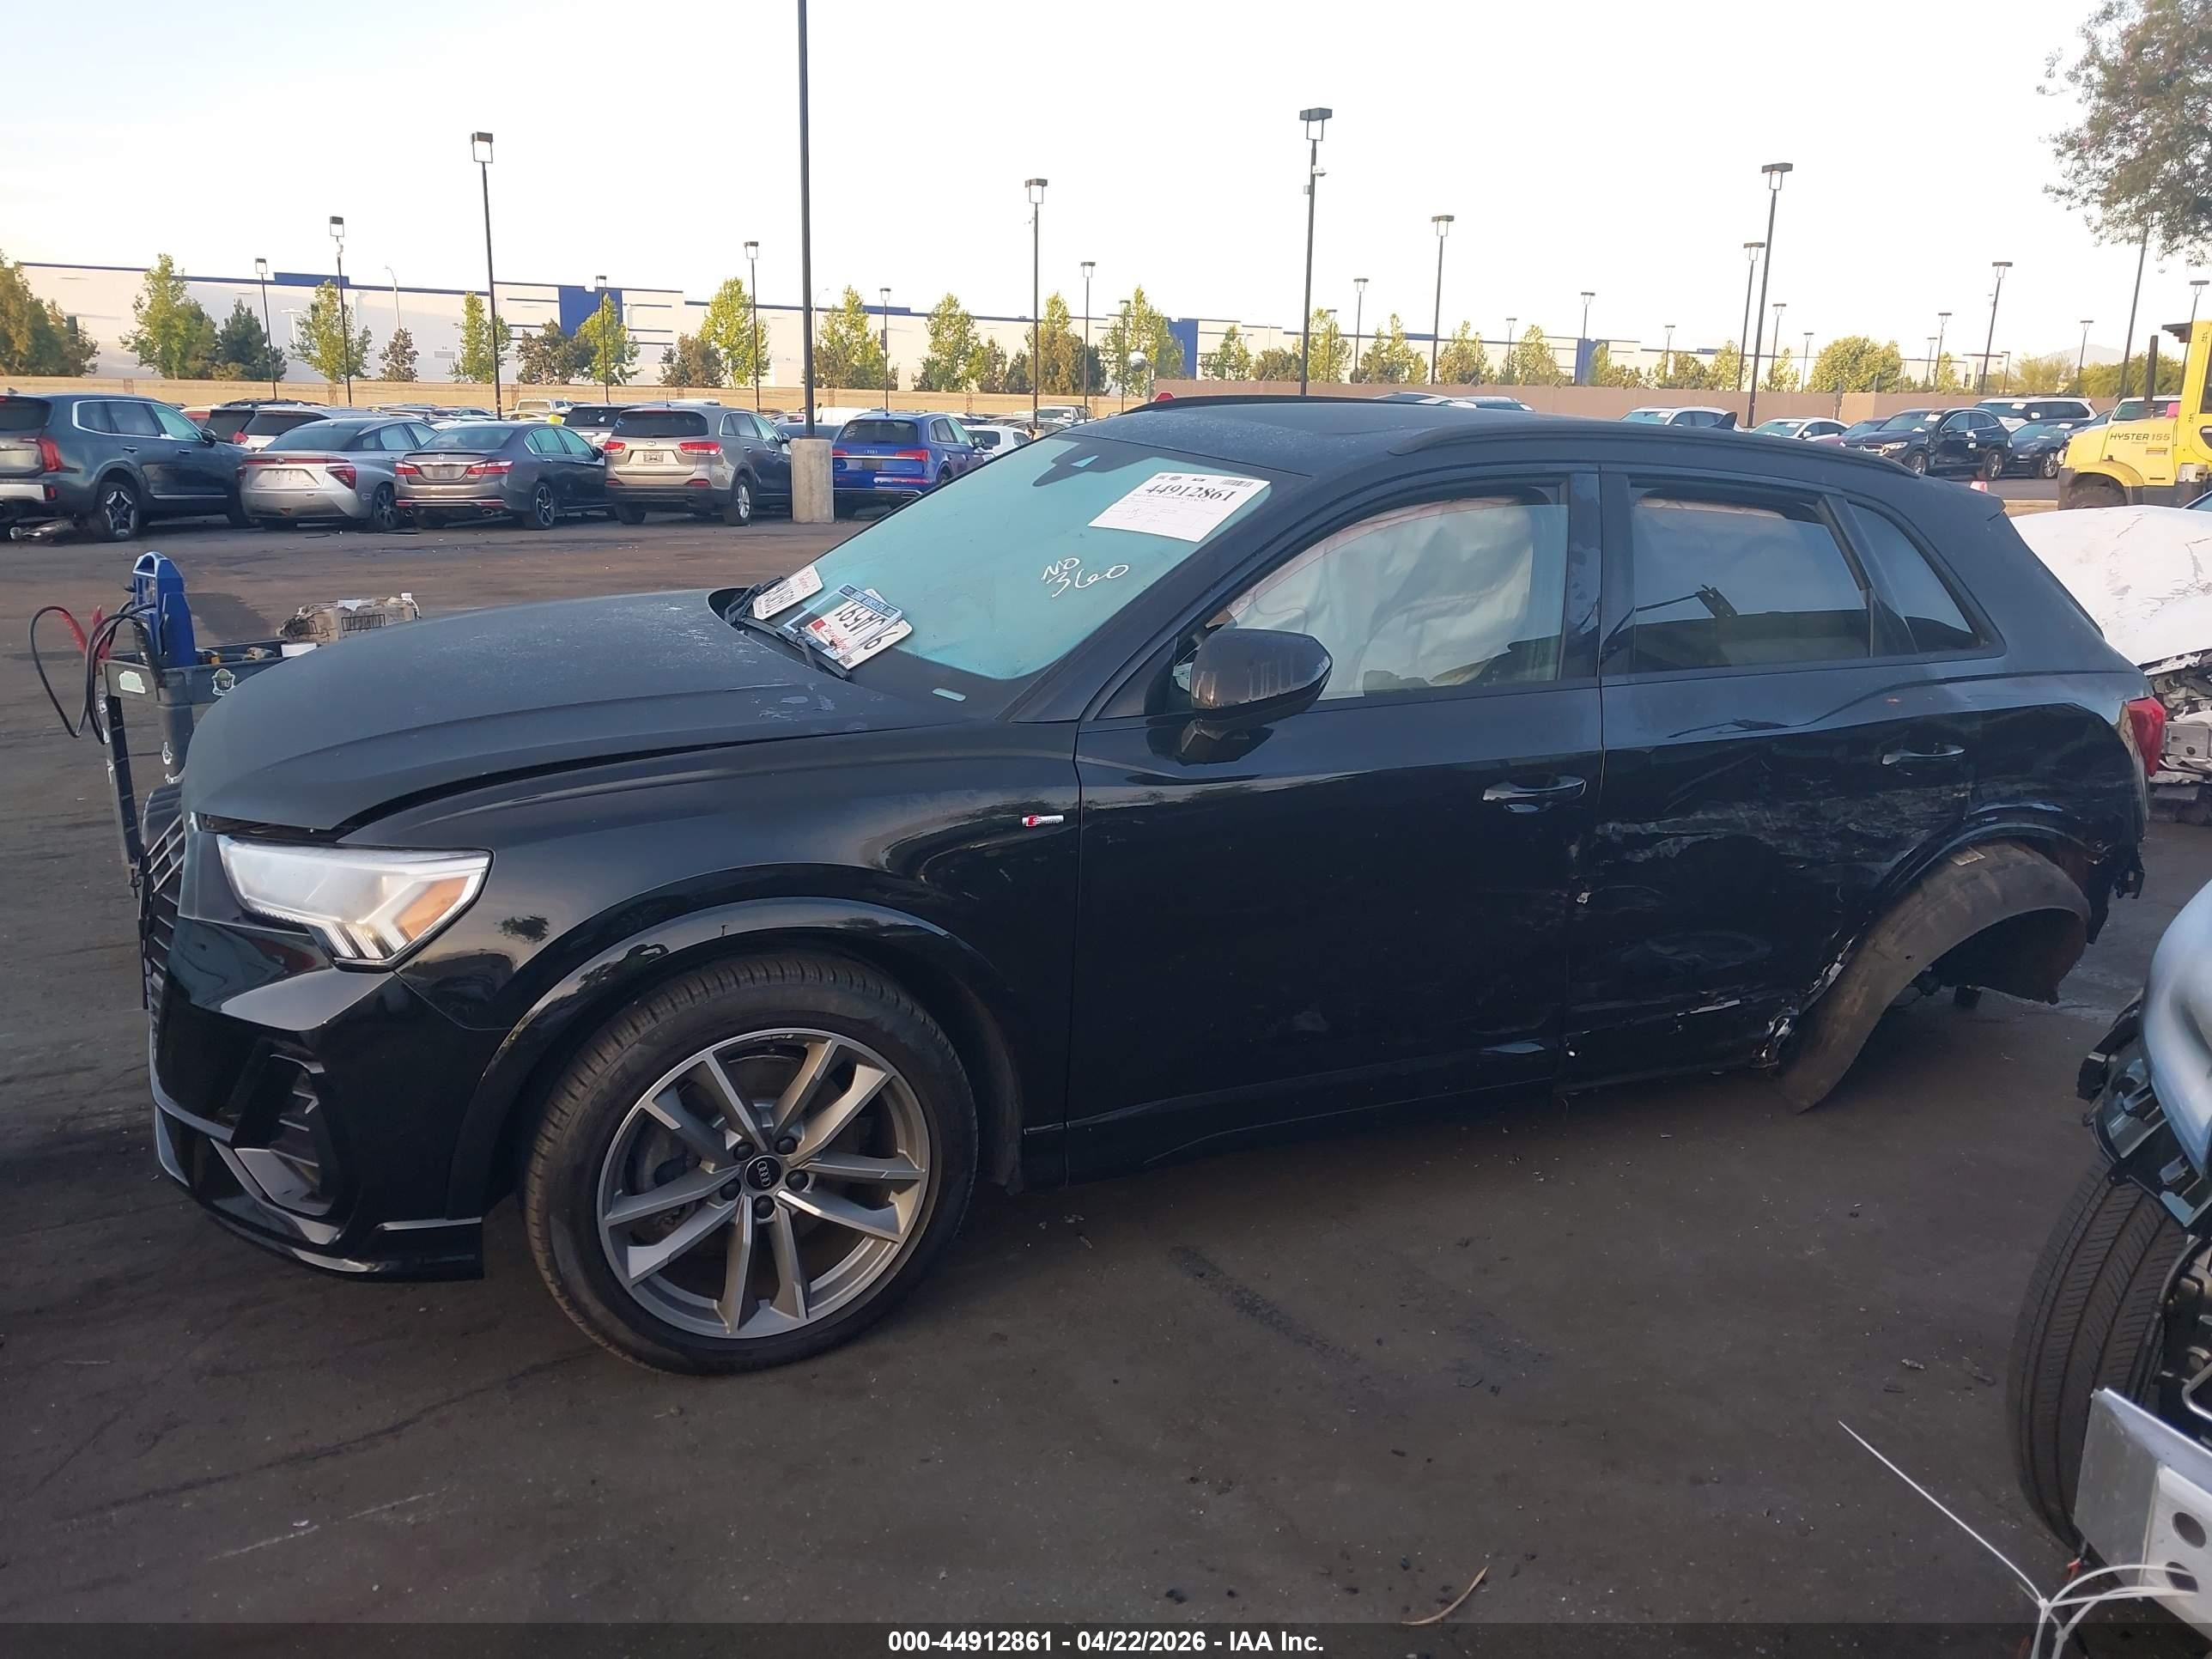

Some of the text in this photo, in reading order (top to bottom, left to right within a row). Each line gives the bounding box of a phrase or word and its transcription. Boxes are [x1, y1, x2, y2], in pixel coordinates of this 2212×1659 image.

[2109, 432, 2149, 441] HYSTER
[1145, 483, 1237, 501] 44912861
[1047, 563, 1130, 599] 360
[834, 602, 898, 650] 9JA591
